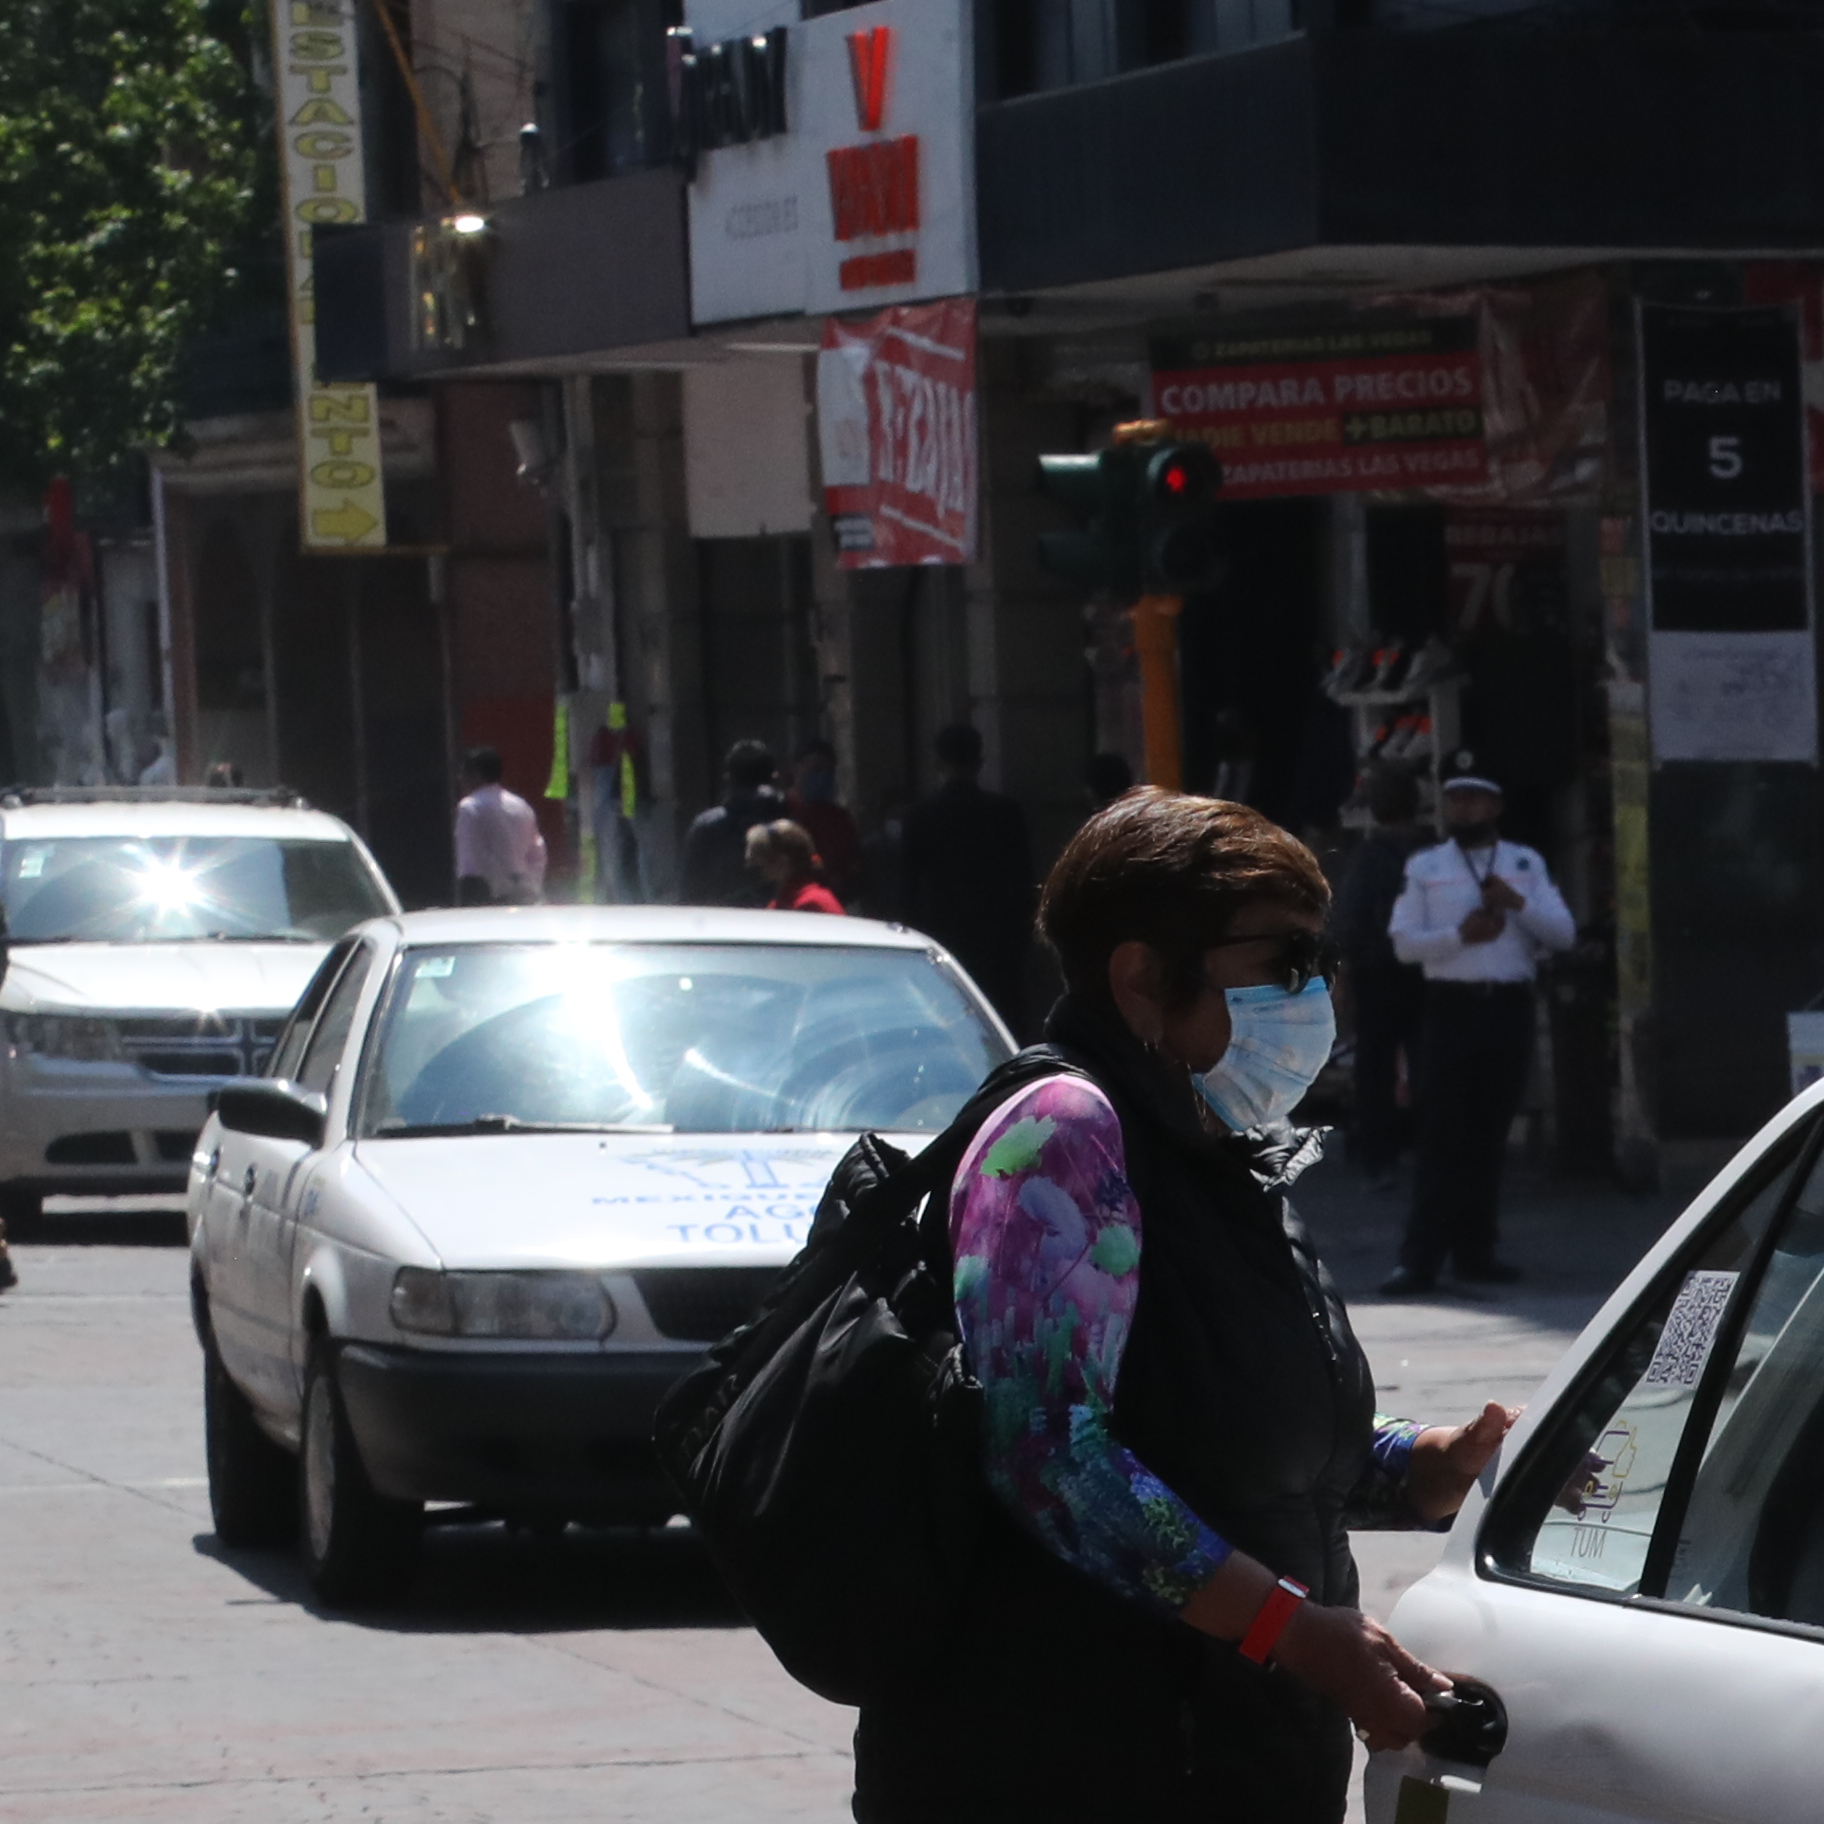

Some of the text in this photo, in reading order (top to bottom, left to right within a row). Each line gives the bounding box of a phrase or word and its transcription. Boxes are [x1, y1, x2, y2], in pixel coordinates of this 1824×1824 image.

[289, 0, 375, 488] ESTACIONTO
[1160, 364, 1473, 415] COMPARA PRECIOS
[1663, 379, 1782, 403] PAGA EN
[1356, 452, 1400, 476] LAS
[1402, 447, 1480, 473] VEGAS
[1708, 434, 1744, 480] 5
[1650, 508, 1804, 536] QUINCENAS
[724, 1204, 816, 1220] AG
